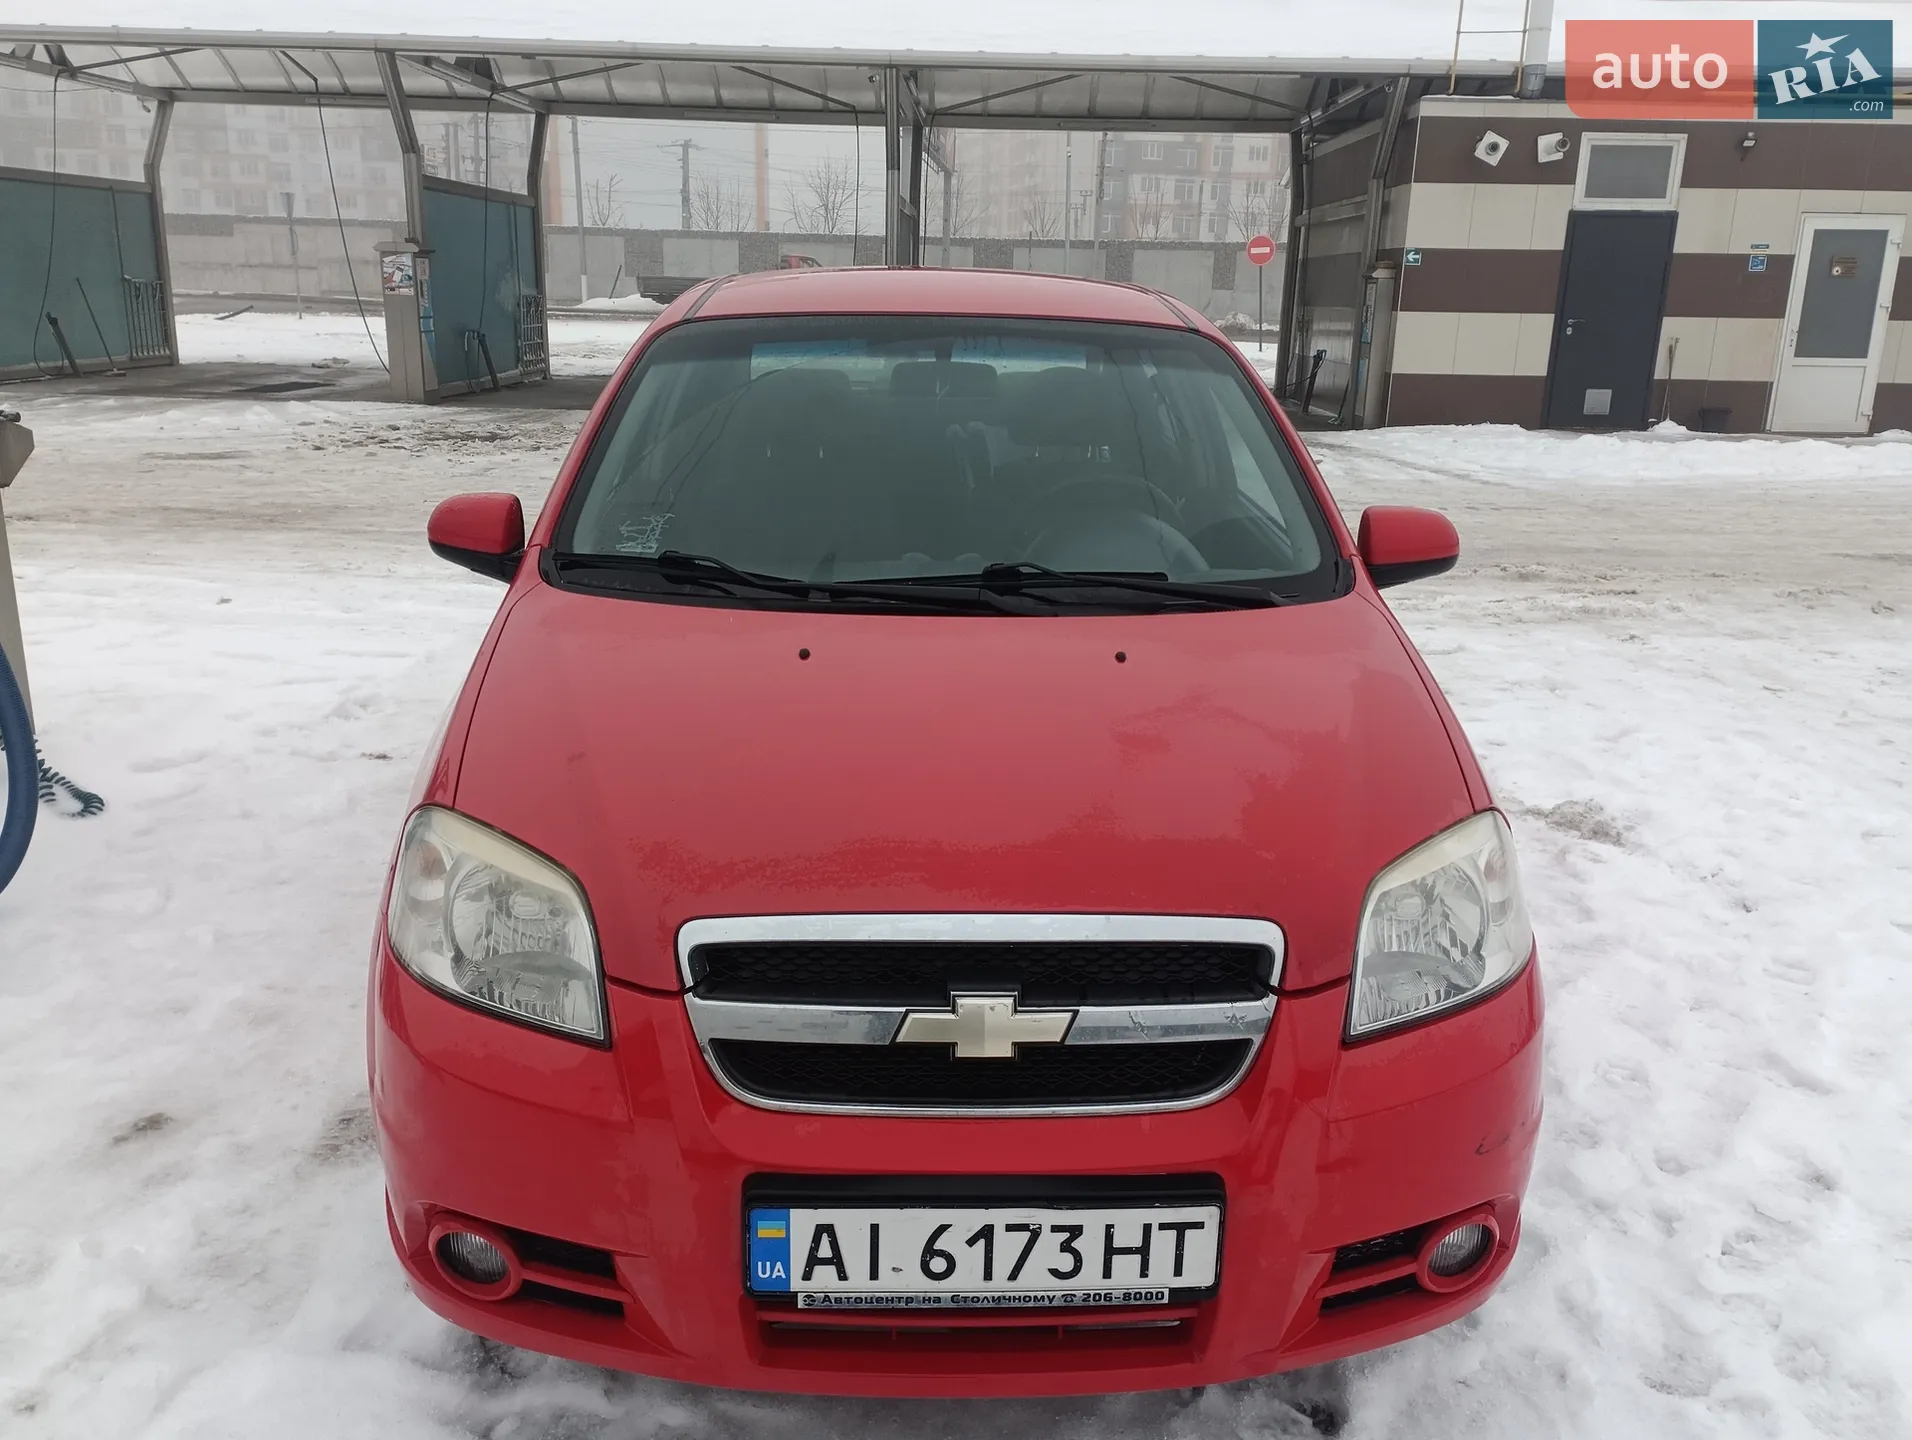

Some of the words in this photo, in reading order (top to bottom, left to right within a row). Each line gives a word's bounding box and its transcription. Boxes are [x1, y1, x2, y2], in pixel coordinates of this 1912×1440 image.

[920, 1223, 1084, 1282] 6173
[757, 1261, 787, 1280] UA
[820, 1294, 915, 1307] Автоцентр
[922, 1295, 942, 1305] на
[950, 1293, 1056, 1305] Столичному
[1081, 1290, 1166, 1304] 206-8000
